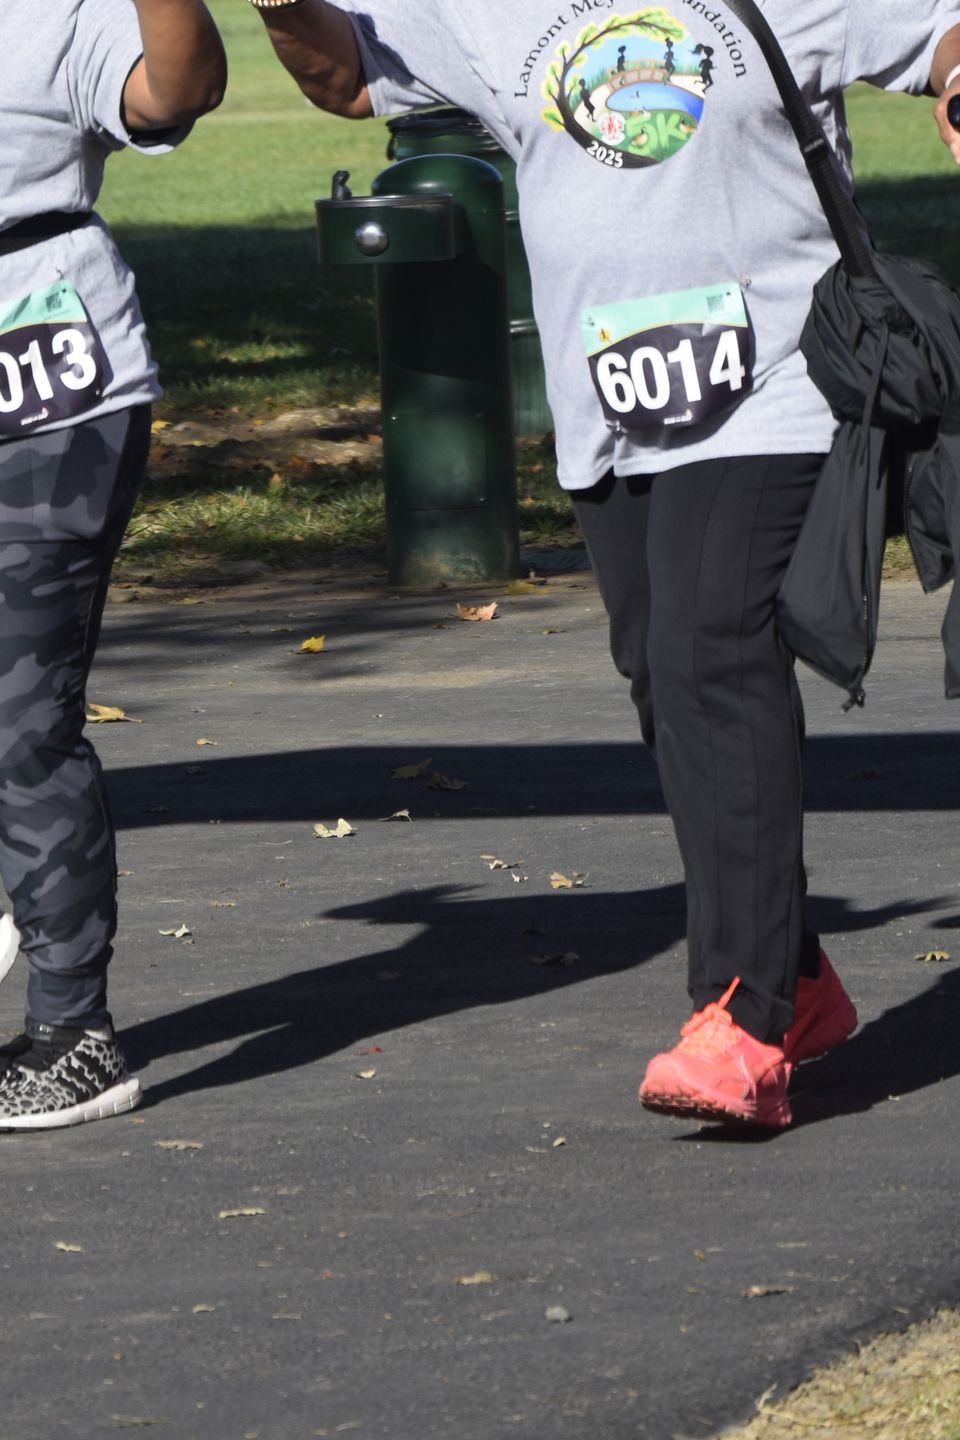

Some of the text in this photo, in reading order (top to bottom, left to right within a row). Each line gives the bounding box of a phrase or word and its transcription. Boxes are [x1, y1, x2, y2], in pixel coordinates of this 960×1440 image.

[514, 14, 569, 98] Lamont
[586, 140, 624, 168] 2025
[624, 112, 689, 156] 5K
[597, 329, 746, 413] 6014
